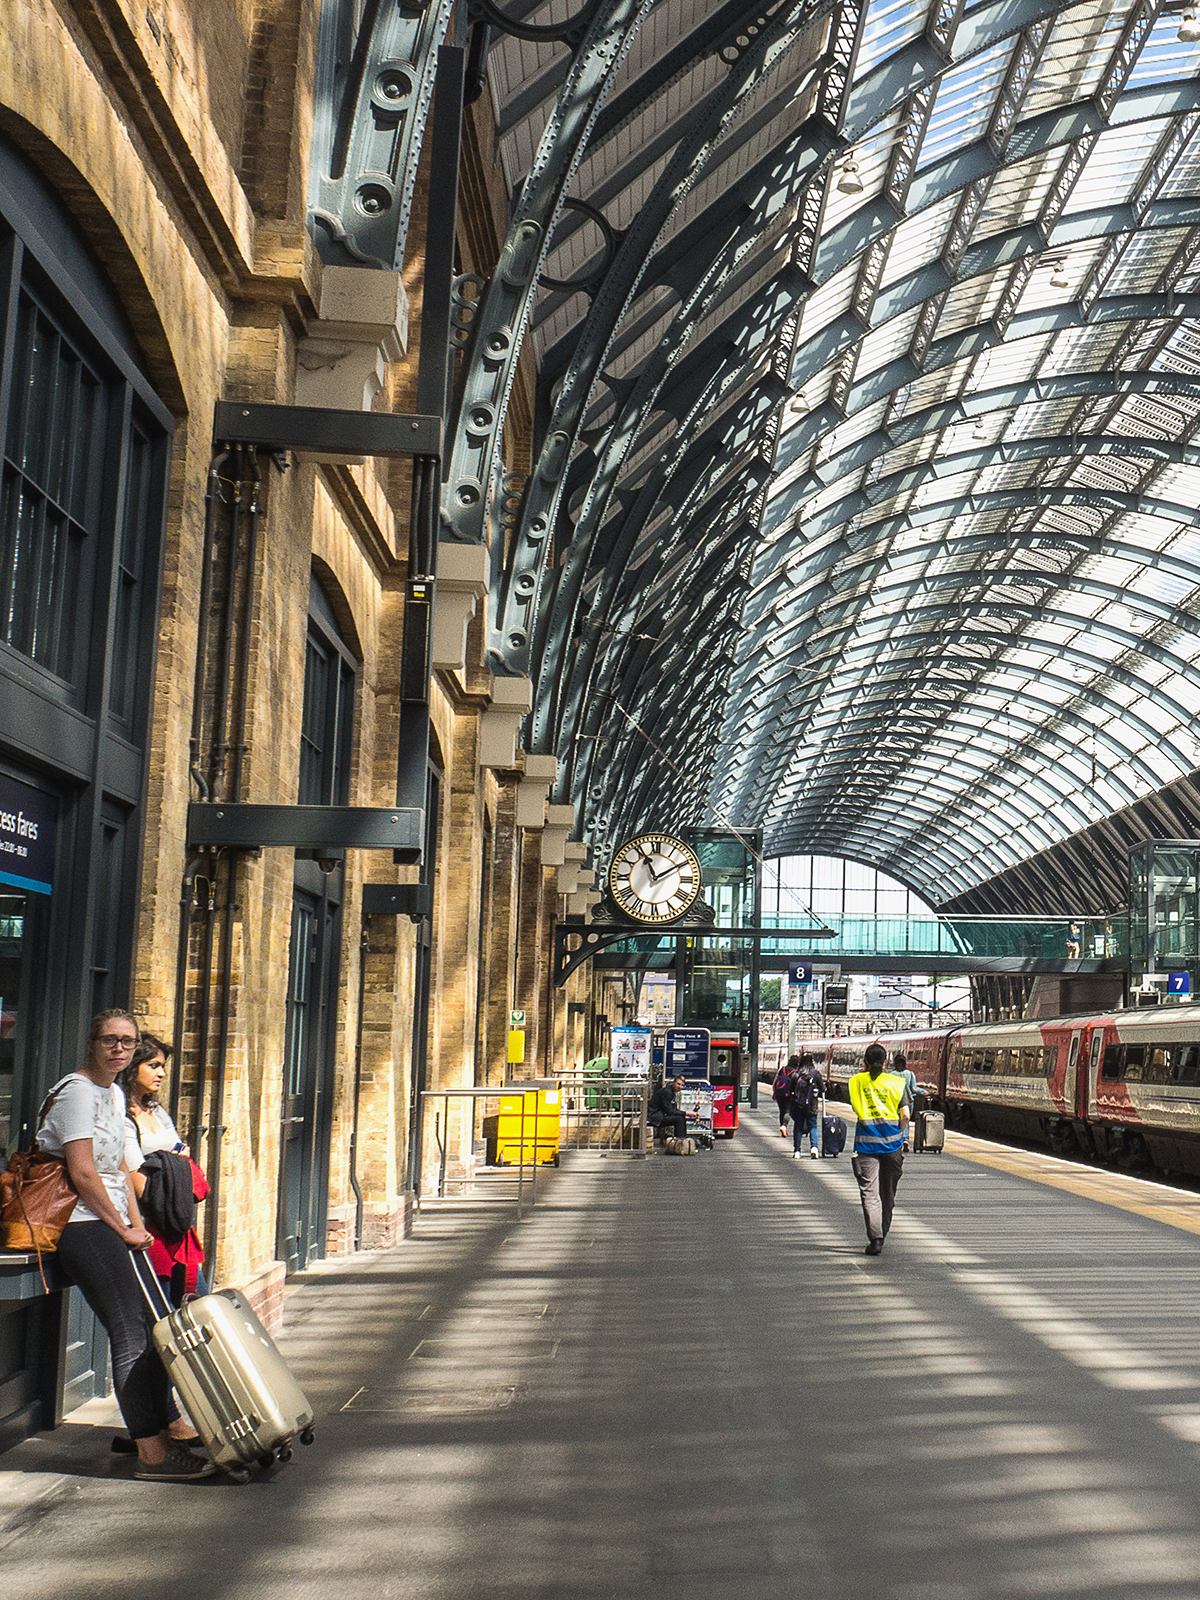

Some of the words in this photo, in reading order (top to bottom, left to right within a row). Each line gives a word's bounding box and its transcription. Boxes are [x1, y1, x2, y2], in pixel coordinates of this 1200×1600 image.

[17, 811, 39, 840] fares
[796, 966, 805, 979] 8
[1174, 977, 1183, 989] 7
